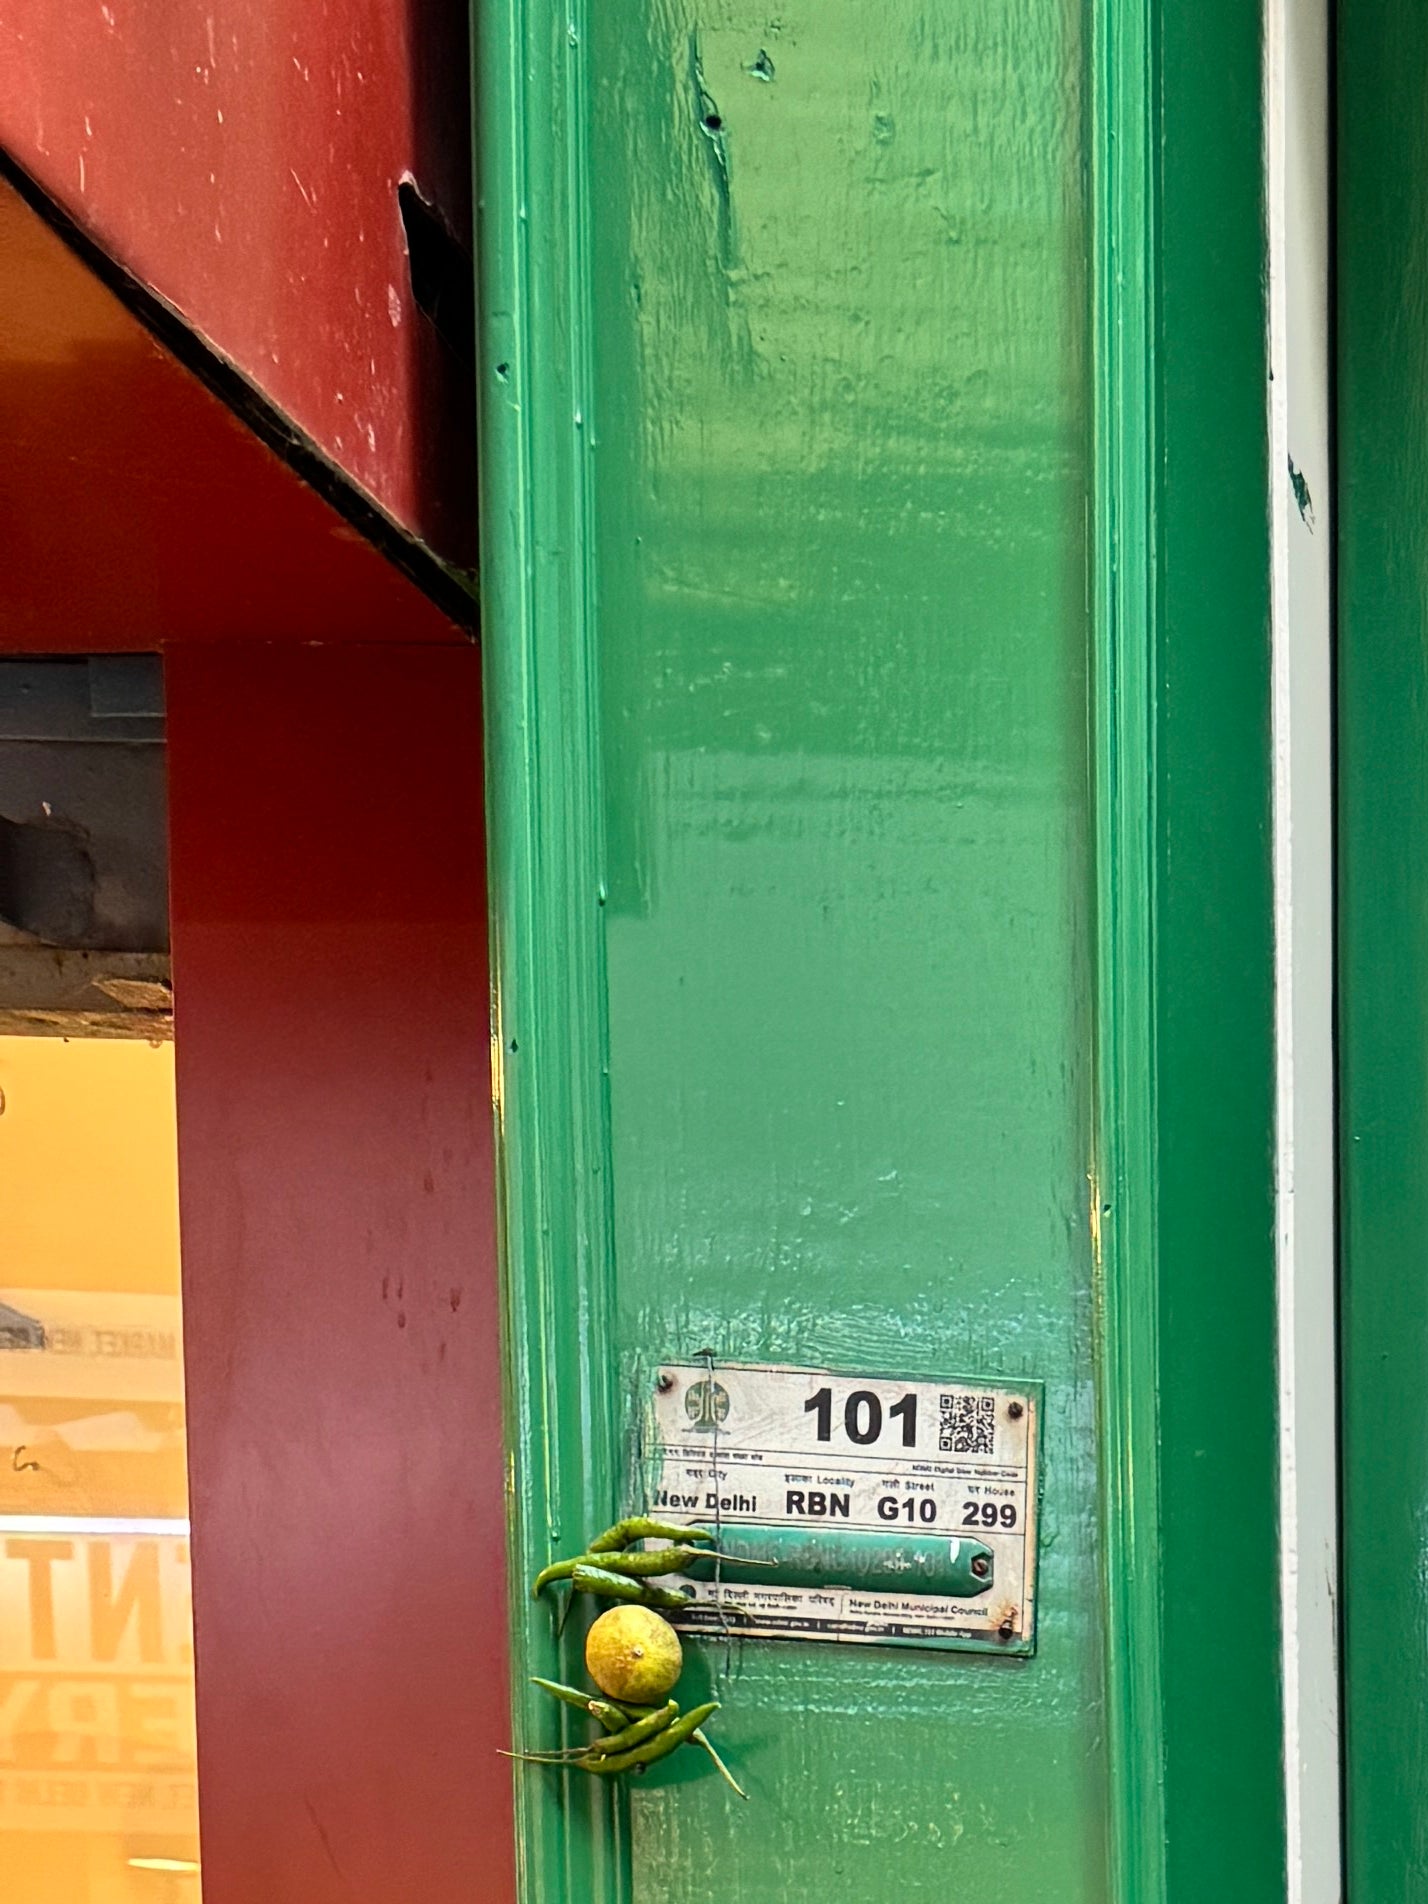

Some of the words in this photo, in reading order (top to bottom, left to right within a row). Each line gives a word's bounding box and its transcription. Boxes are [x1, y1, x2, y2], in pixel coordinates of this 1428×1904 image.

[804, 1388, 918, 1447] 101
[817, 1476, 855, 1488] Locality
[904, 1480, 935, 1492] Street
[984, 1486, 1016, 1497] House
[654, 1490, 698, 1508] New
[705, 1493, 757, 1512] Delhi
[786, 1490, 850, 1518] RBN
[877, 1496, 937, 1523] G10
[962, 1501, 1017, 1528] 299
[849, 1599, 871, 1608] New
[873, 1600, 898, 1610] Delhi
[901, 1602, 948, 1614] Municipal
[951, 1605, 988, 1616] Council
